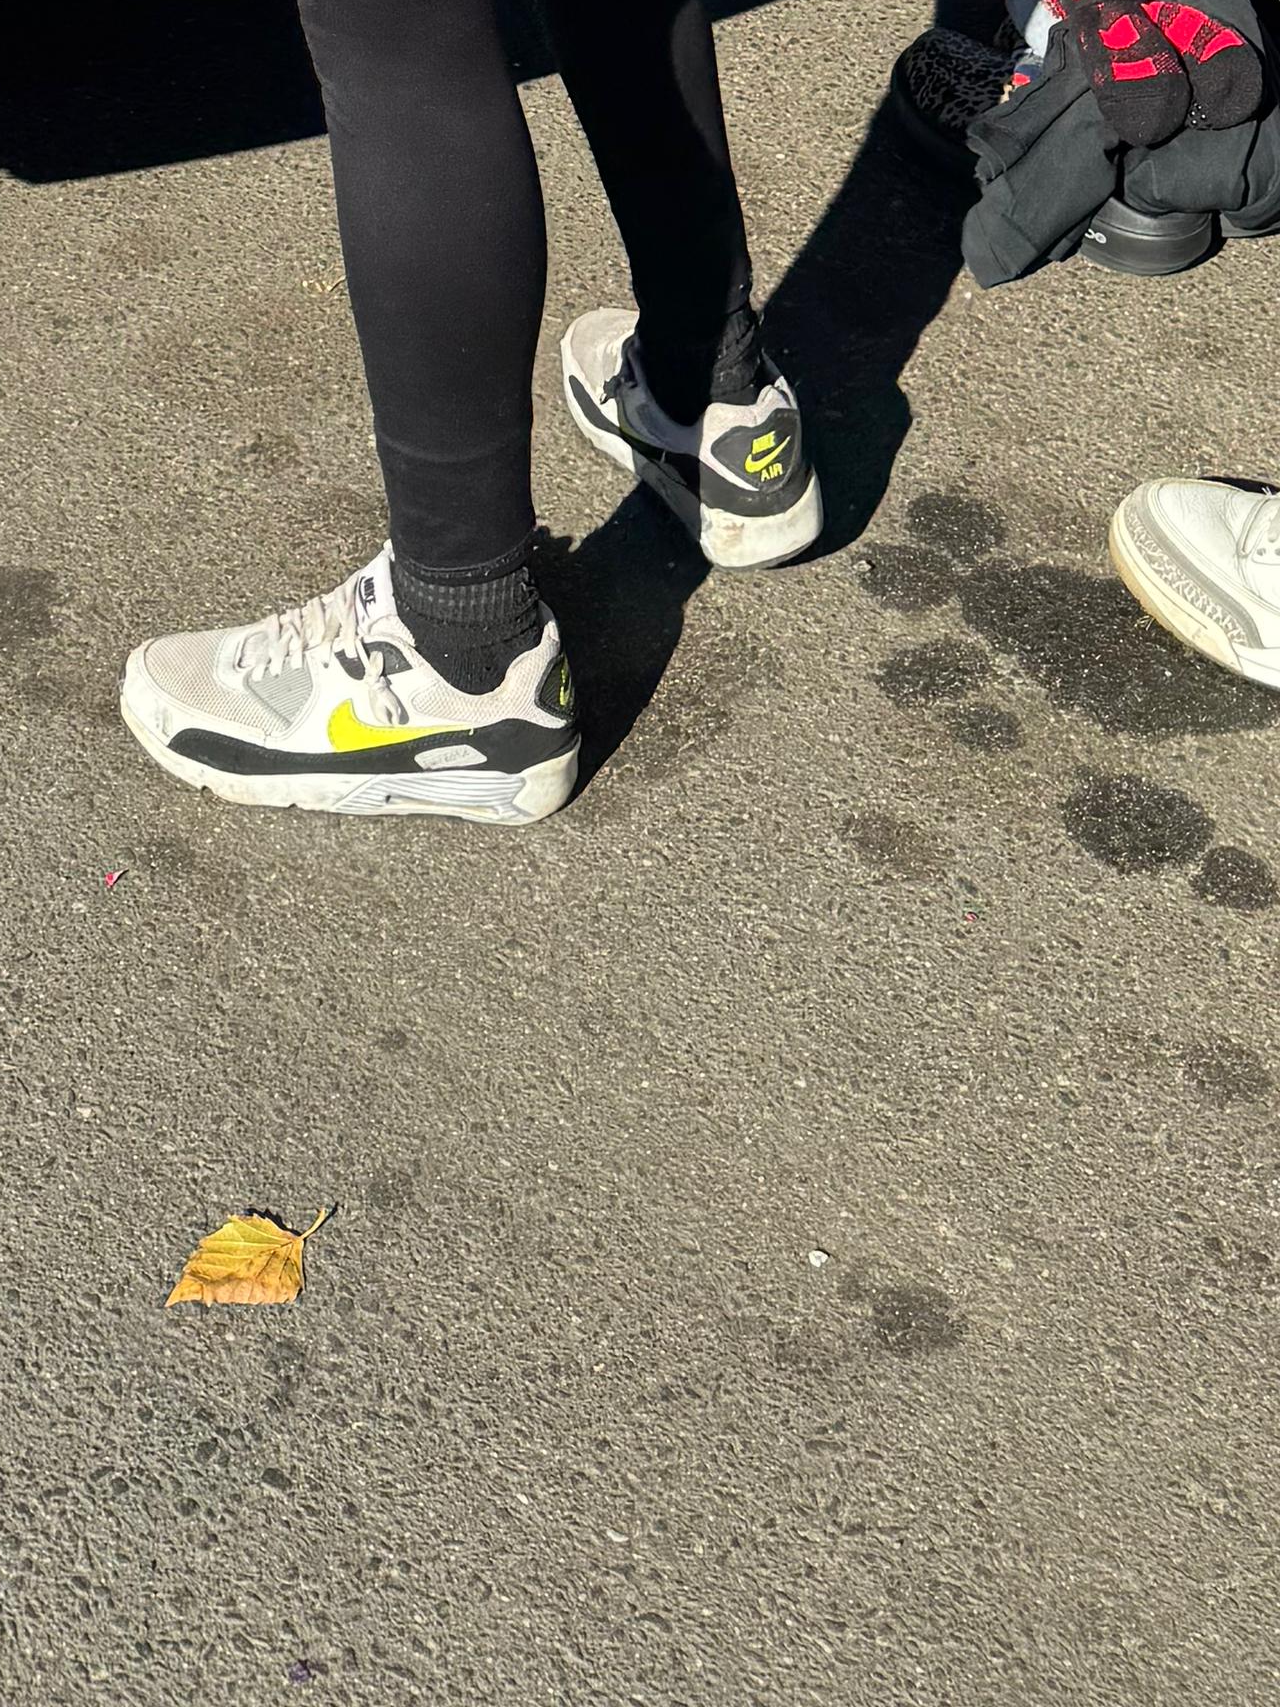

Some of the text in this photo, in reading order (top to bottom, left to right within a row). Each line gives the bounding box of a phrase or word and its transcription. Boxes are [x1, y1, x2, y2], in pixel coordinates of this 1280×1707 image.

[752, 430, 776, 455] NIKE
[761, 462, 783, 482] AIR
[363, 576, 376, 605] NIKE
